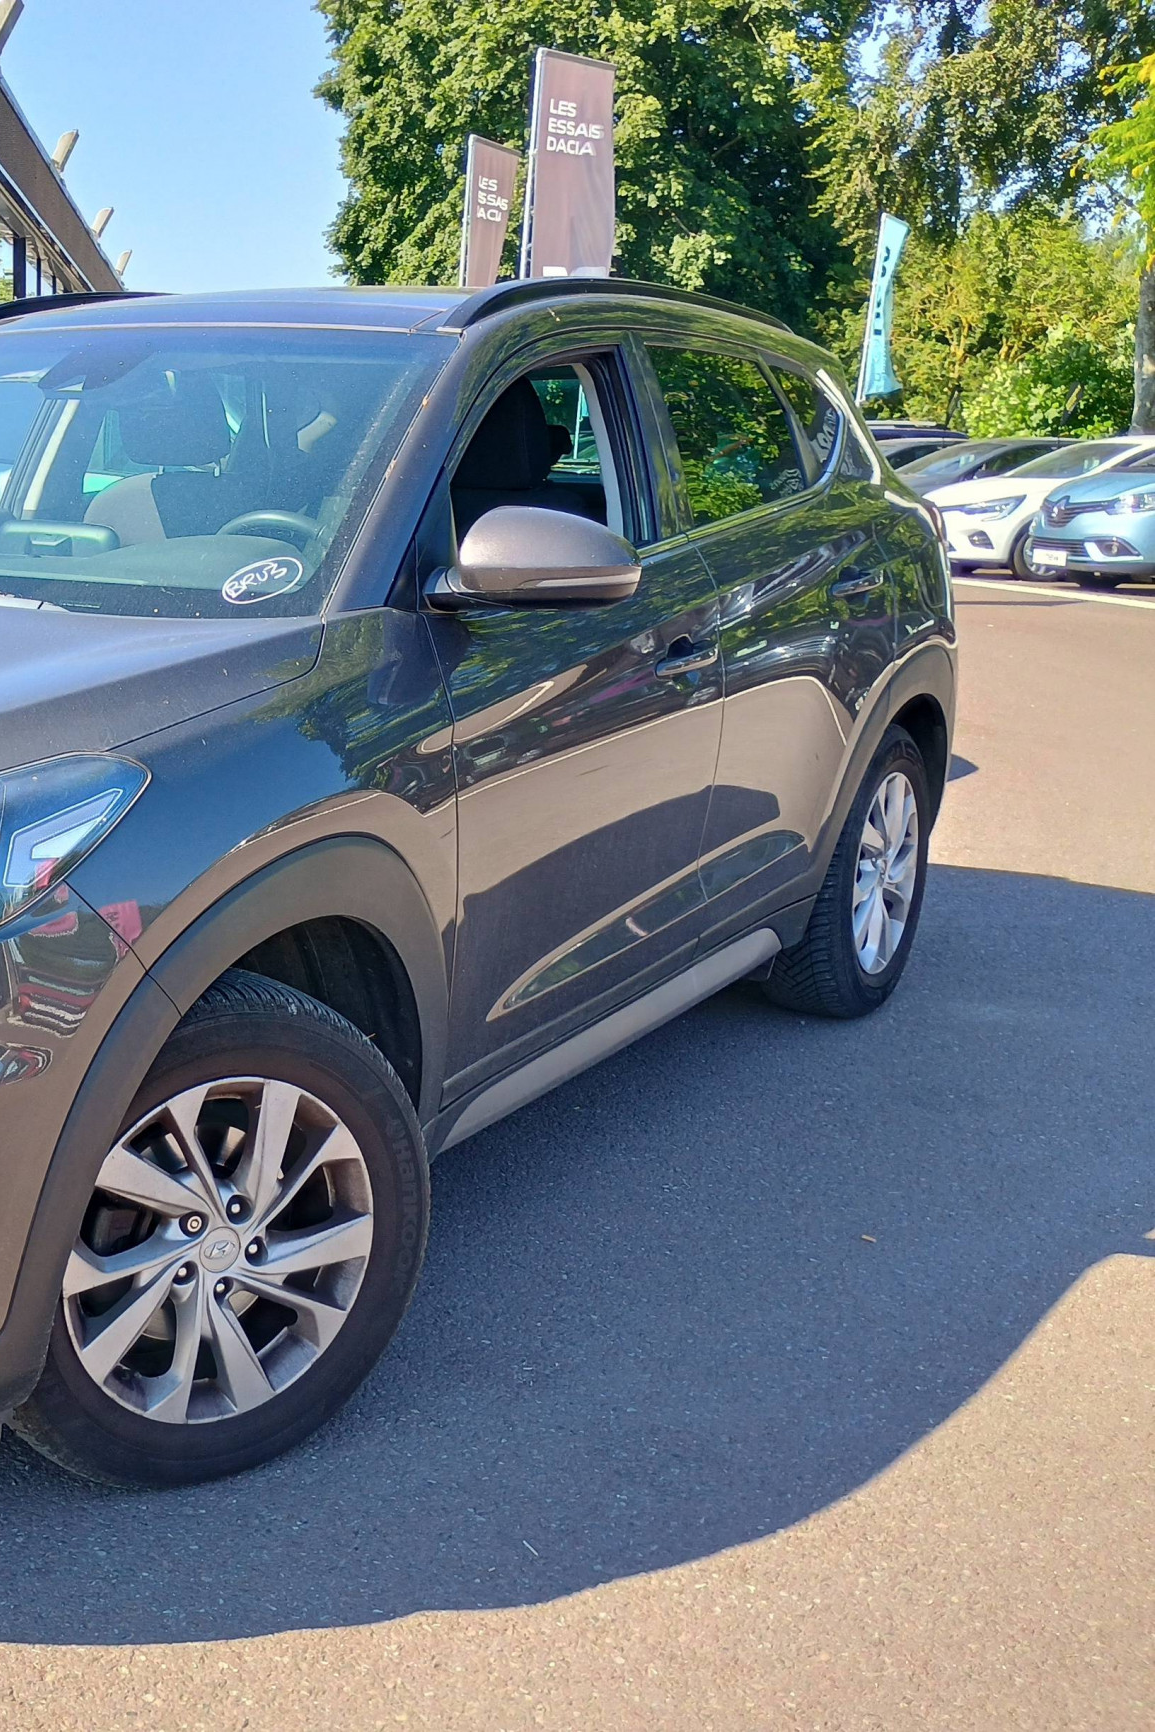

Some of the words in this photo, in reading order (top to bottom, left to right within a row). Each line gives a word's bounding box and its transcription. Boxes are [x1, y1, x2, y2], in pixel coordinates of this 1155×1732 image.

[549, 98, 577, 118] LES
[547, 117, 605, 140] ESSAIS
[546, 135, 597, 156] DACIA
